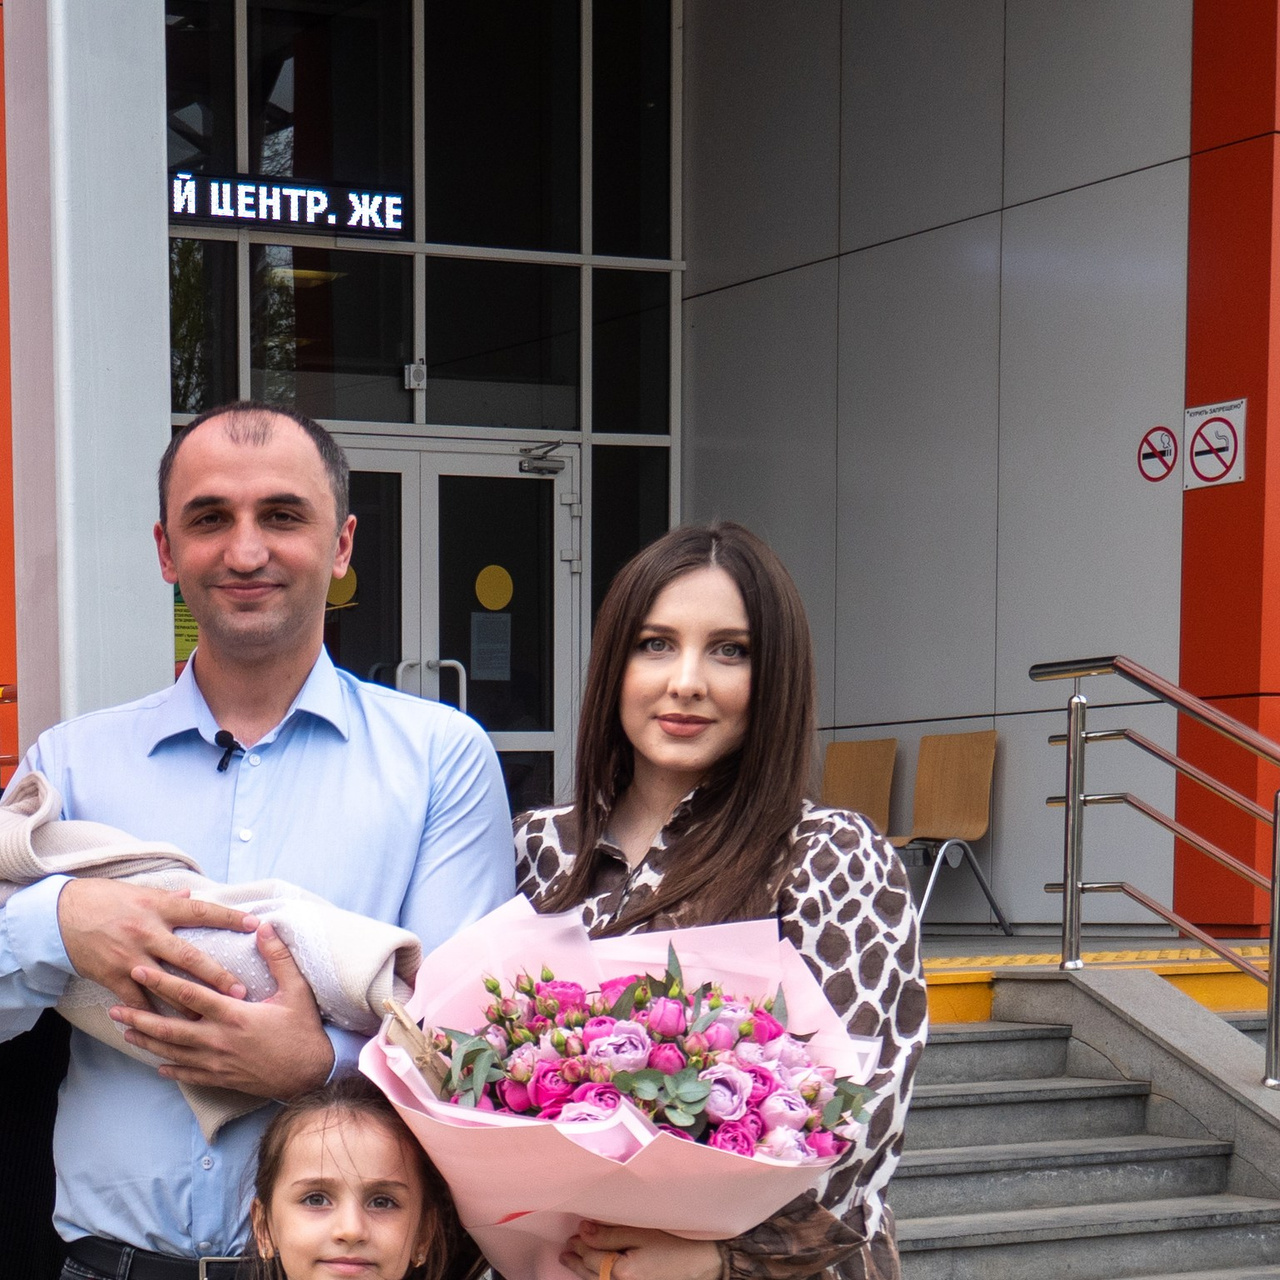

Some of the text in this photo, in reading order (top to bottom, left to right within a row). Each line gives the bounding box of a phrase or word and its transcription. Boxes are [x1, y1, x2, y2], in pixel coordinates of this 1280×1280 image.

[172, 172, 403, 230] Й ЦЕНТР. ЖЕ
[1189, 403, 1241, 417] КУРИТЬ ЗАПРЕЩЕНО
